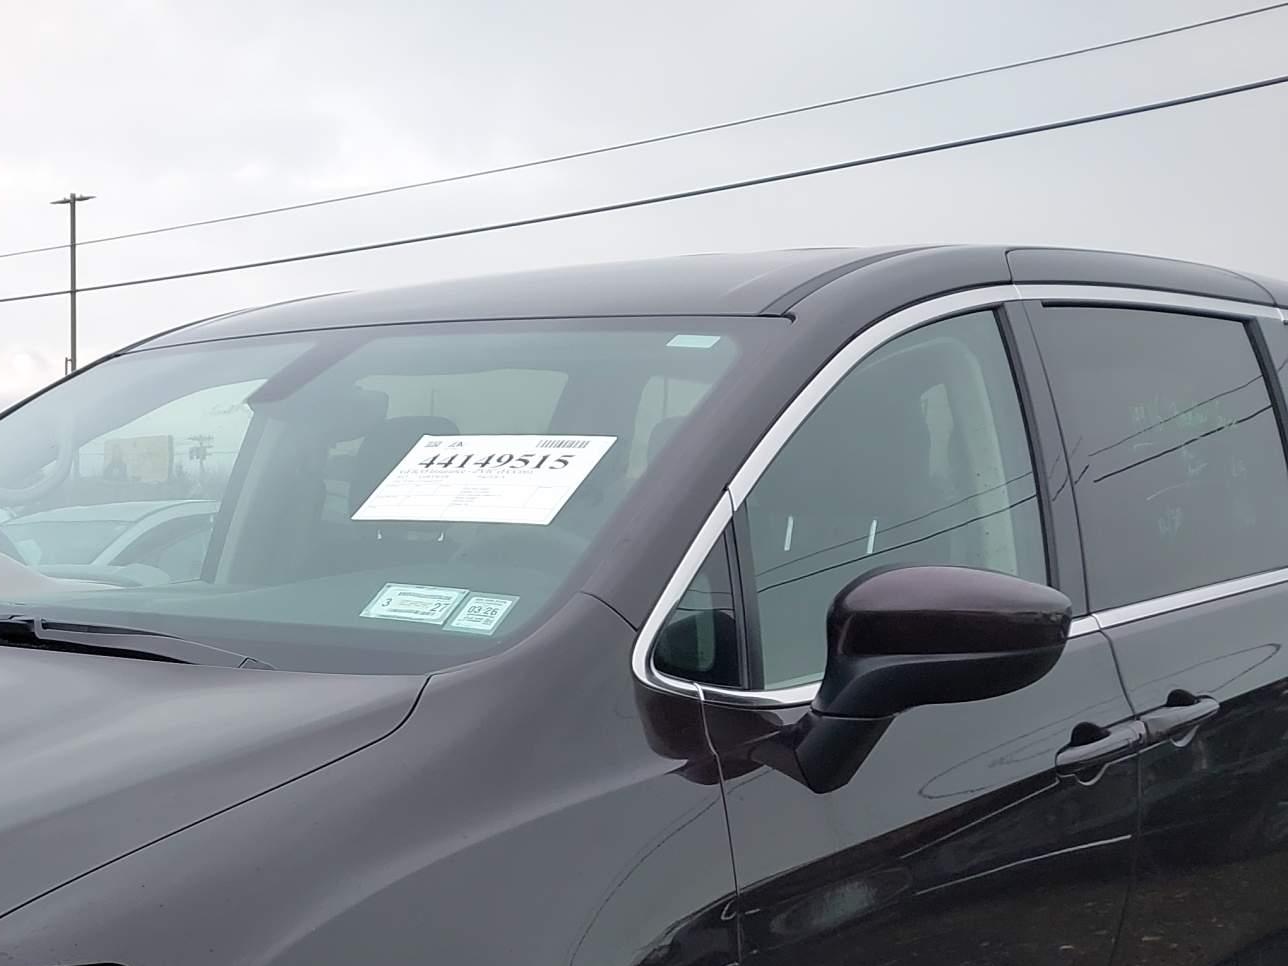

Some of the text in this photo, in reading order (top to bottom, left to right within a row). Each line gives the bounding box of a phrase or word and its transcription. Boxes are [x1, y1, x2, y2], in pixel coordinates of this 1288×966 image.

[418, 452, 576, 470] 44149515
[381, 598, 392, 607] 3
[430, 602, 450, 613] 27
